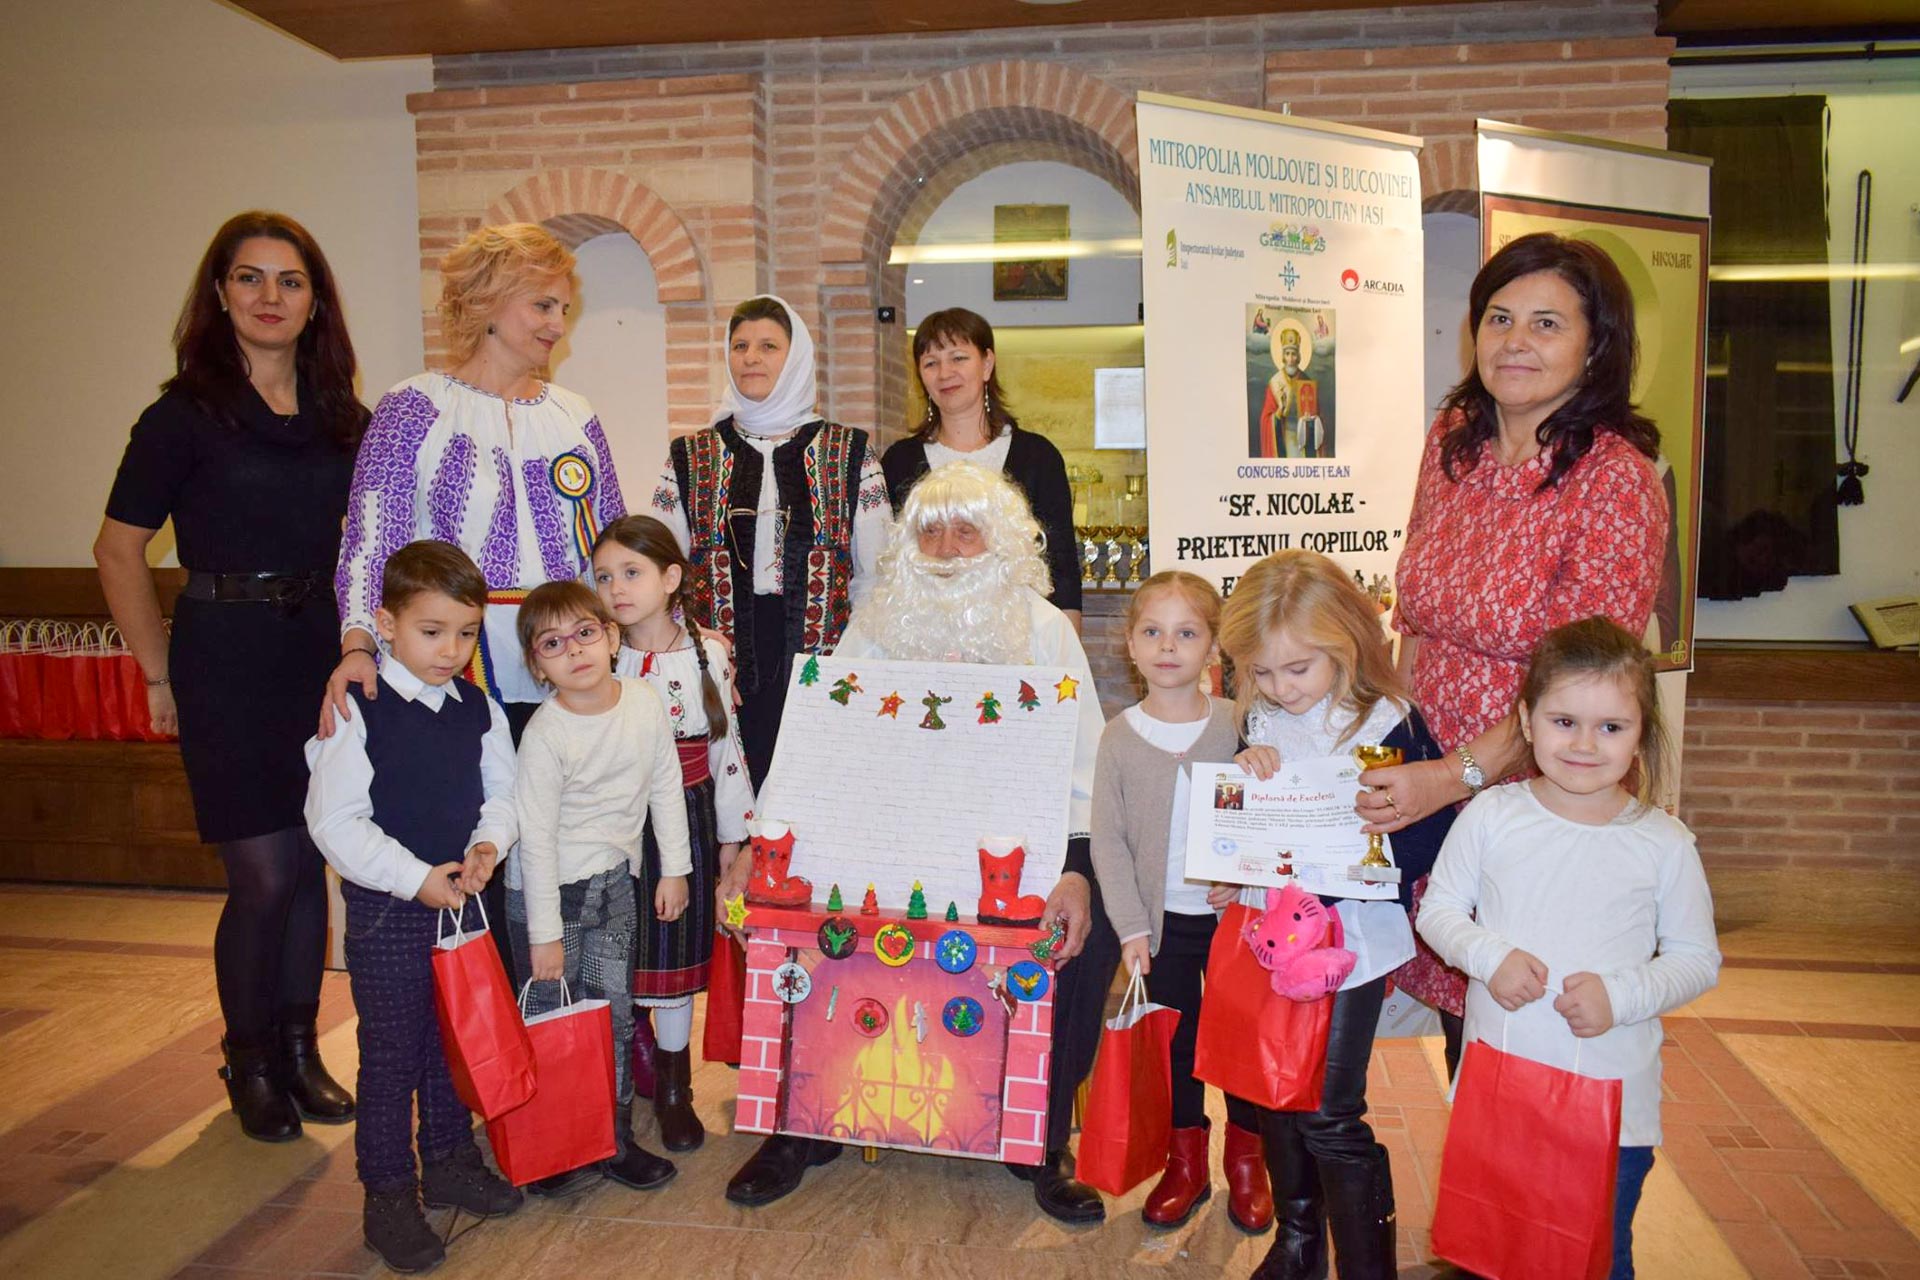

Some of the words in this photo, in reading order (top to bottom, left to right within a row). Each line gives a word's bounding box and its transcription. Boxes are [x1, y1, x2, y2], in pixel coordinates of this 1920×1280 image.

[1149, 138, 1241, 176] MITROPOLIA
[1246, 152, 1321, 185] MOLDOVEI
[1342, 166, 1413, 199] BUCOVINEI
[1185, 182, 1265, 212] ANSAMBLUL
[1269, 192, 1357, 222] MITROPOLITAN
[1313, 236, 1326, 253] 25
[1651, 250, 1692, 269] NICOLAE
[1363, 279, 1405, 294] ARCADIA
[1237, 465, 1290, 479] CONCURS
[1266, 492, 1355, 516] NICOLAE
[1287, 793, 1298, 803] de
